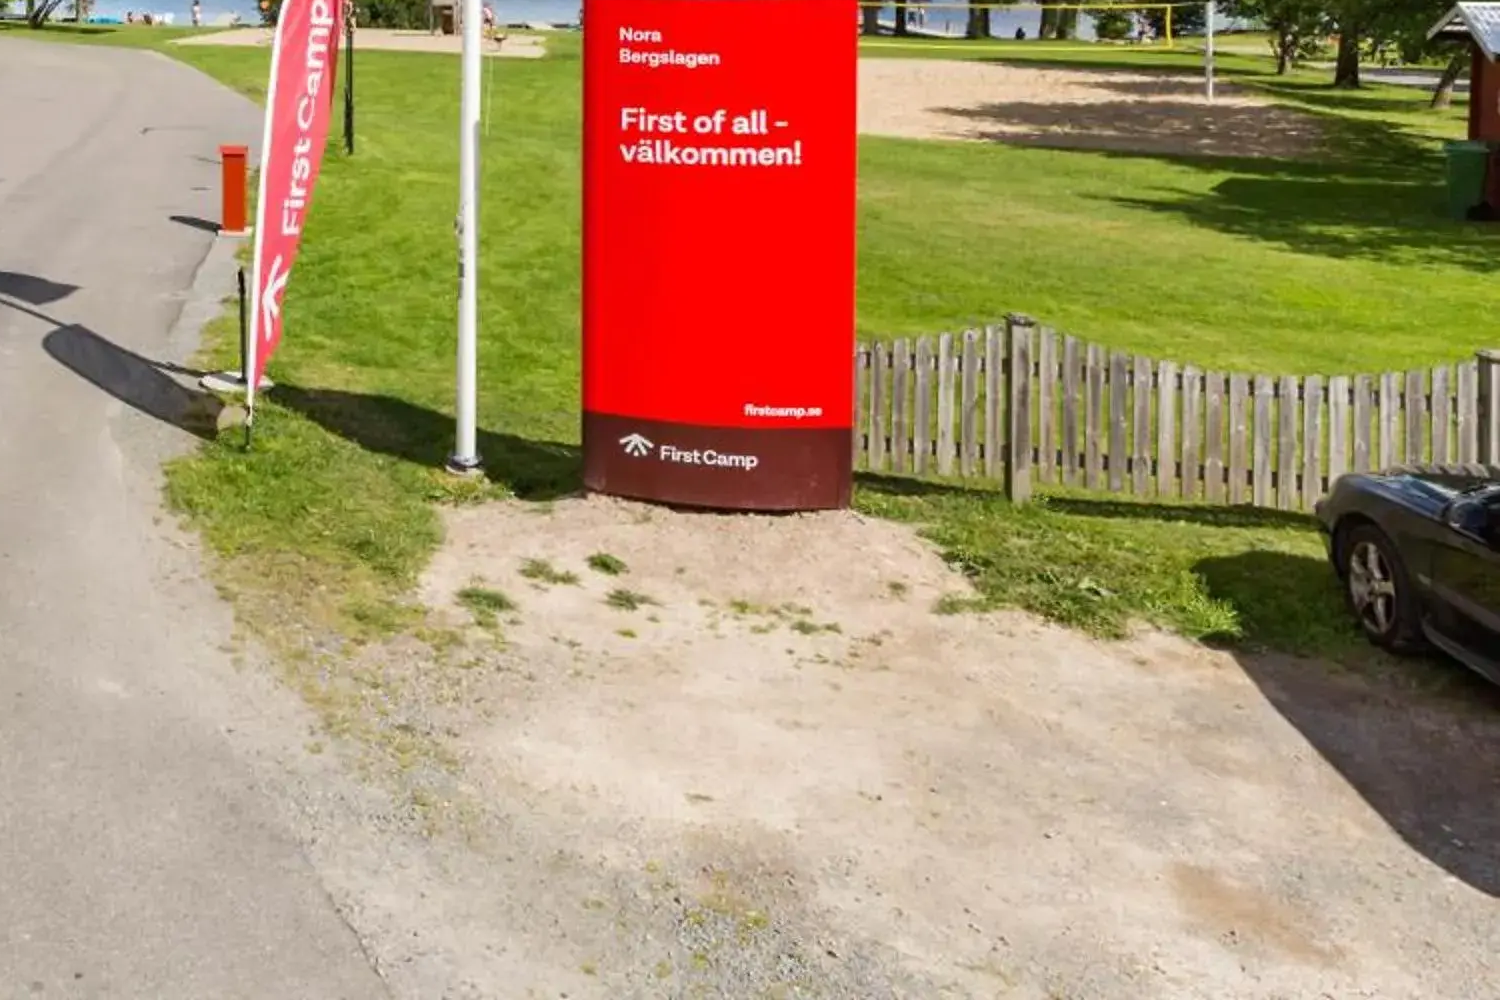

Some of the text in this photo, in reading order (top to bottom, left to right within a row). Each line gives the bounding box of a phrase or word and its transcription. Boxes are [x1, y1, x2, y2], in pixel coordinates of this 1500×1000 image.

[619, 27, 662, 43] Nora
[619, 48, 720, 68] Bergslagen
[621, 107, 688, 134] First
[693, 109, 727, 135] of
[732, 109, 769, 135] all
[620, 139, 802, 165] välkommen!
[282, 137, 312, 236] First
[744, 403, 823, 418] firstcamp.se
[659, 445, 759, 471] First Camp
